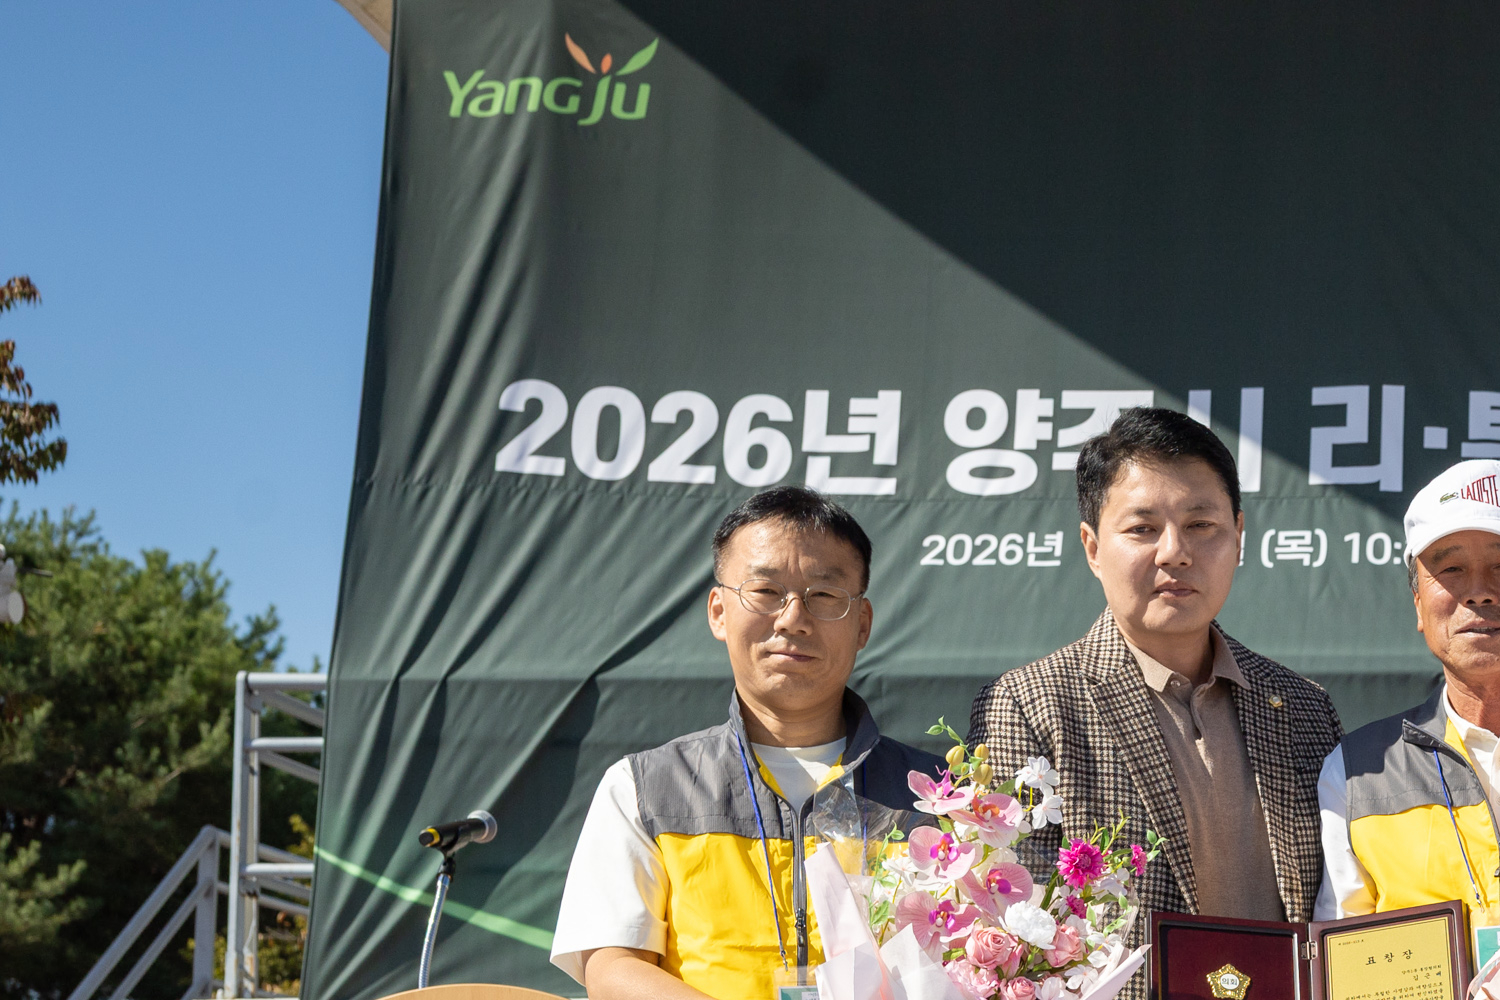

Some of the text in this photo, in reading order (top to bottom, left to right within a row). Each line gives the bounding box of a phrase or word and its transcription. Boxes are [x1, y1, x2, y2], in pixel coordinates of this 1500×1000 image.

[495, 378, 902, 496] 2026년
[1461, 474, 1500, 508] LACOSTE
[919, 530, 1064, 567] 2026년
[1260, 527, 1329, 568] (목)
